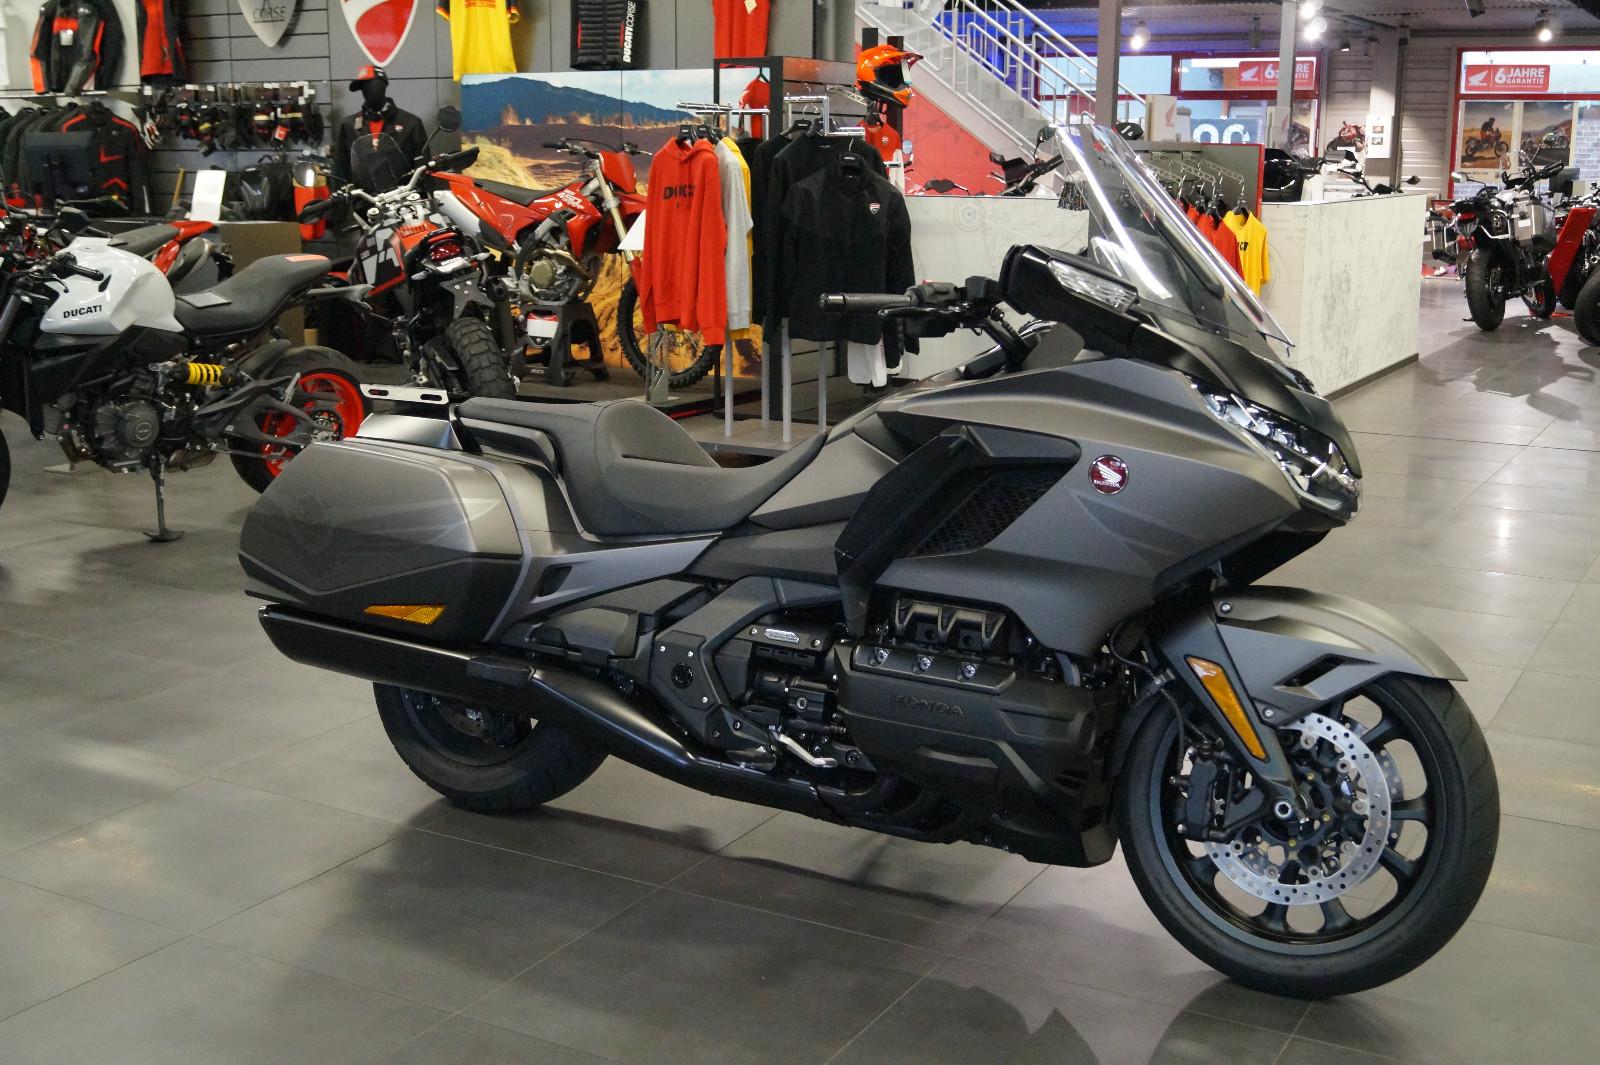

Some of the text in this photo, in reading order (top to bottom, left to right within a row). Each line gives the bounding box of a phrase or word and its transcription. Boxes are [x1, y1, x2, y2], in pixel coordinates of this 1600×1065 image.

[1494, 67, 1545, 84] 6 JAHRE
[63, 304, 103, 319] DUCATI
